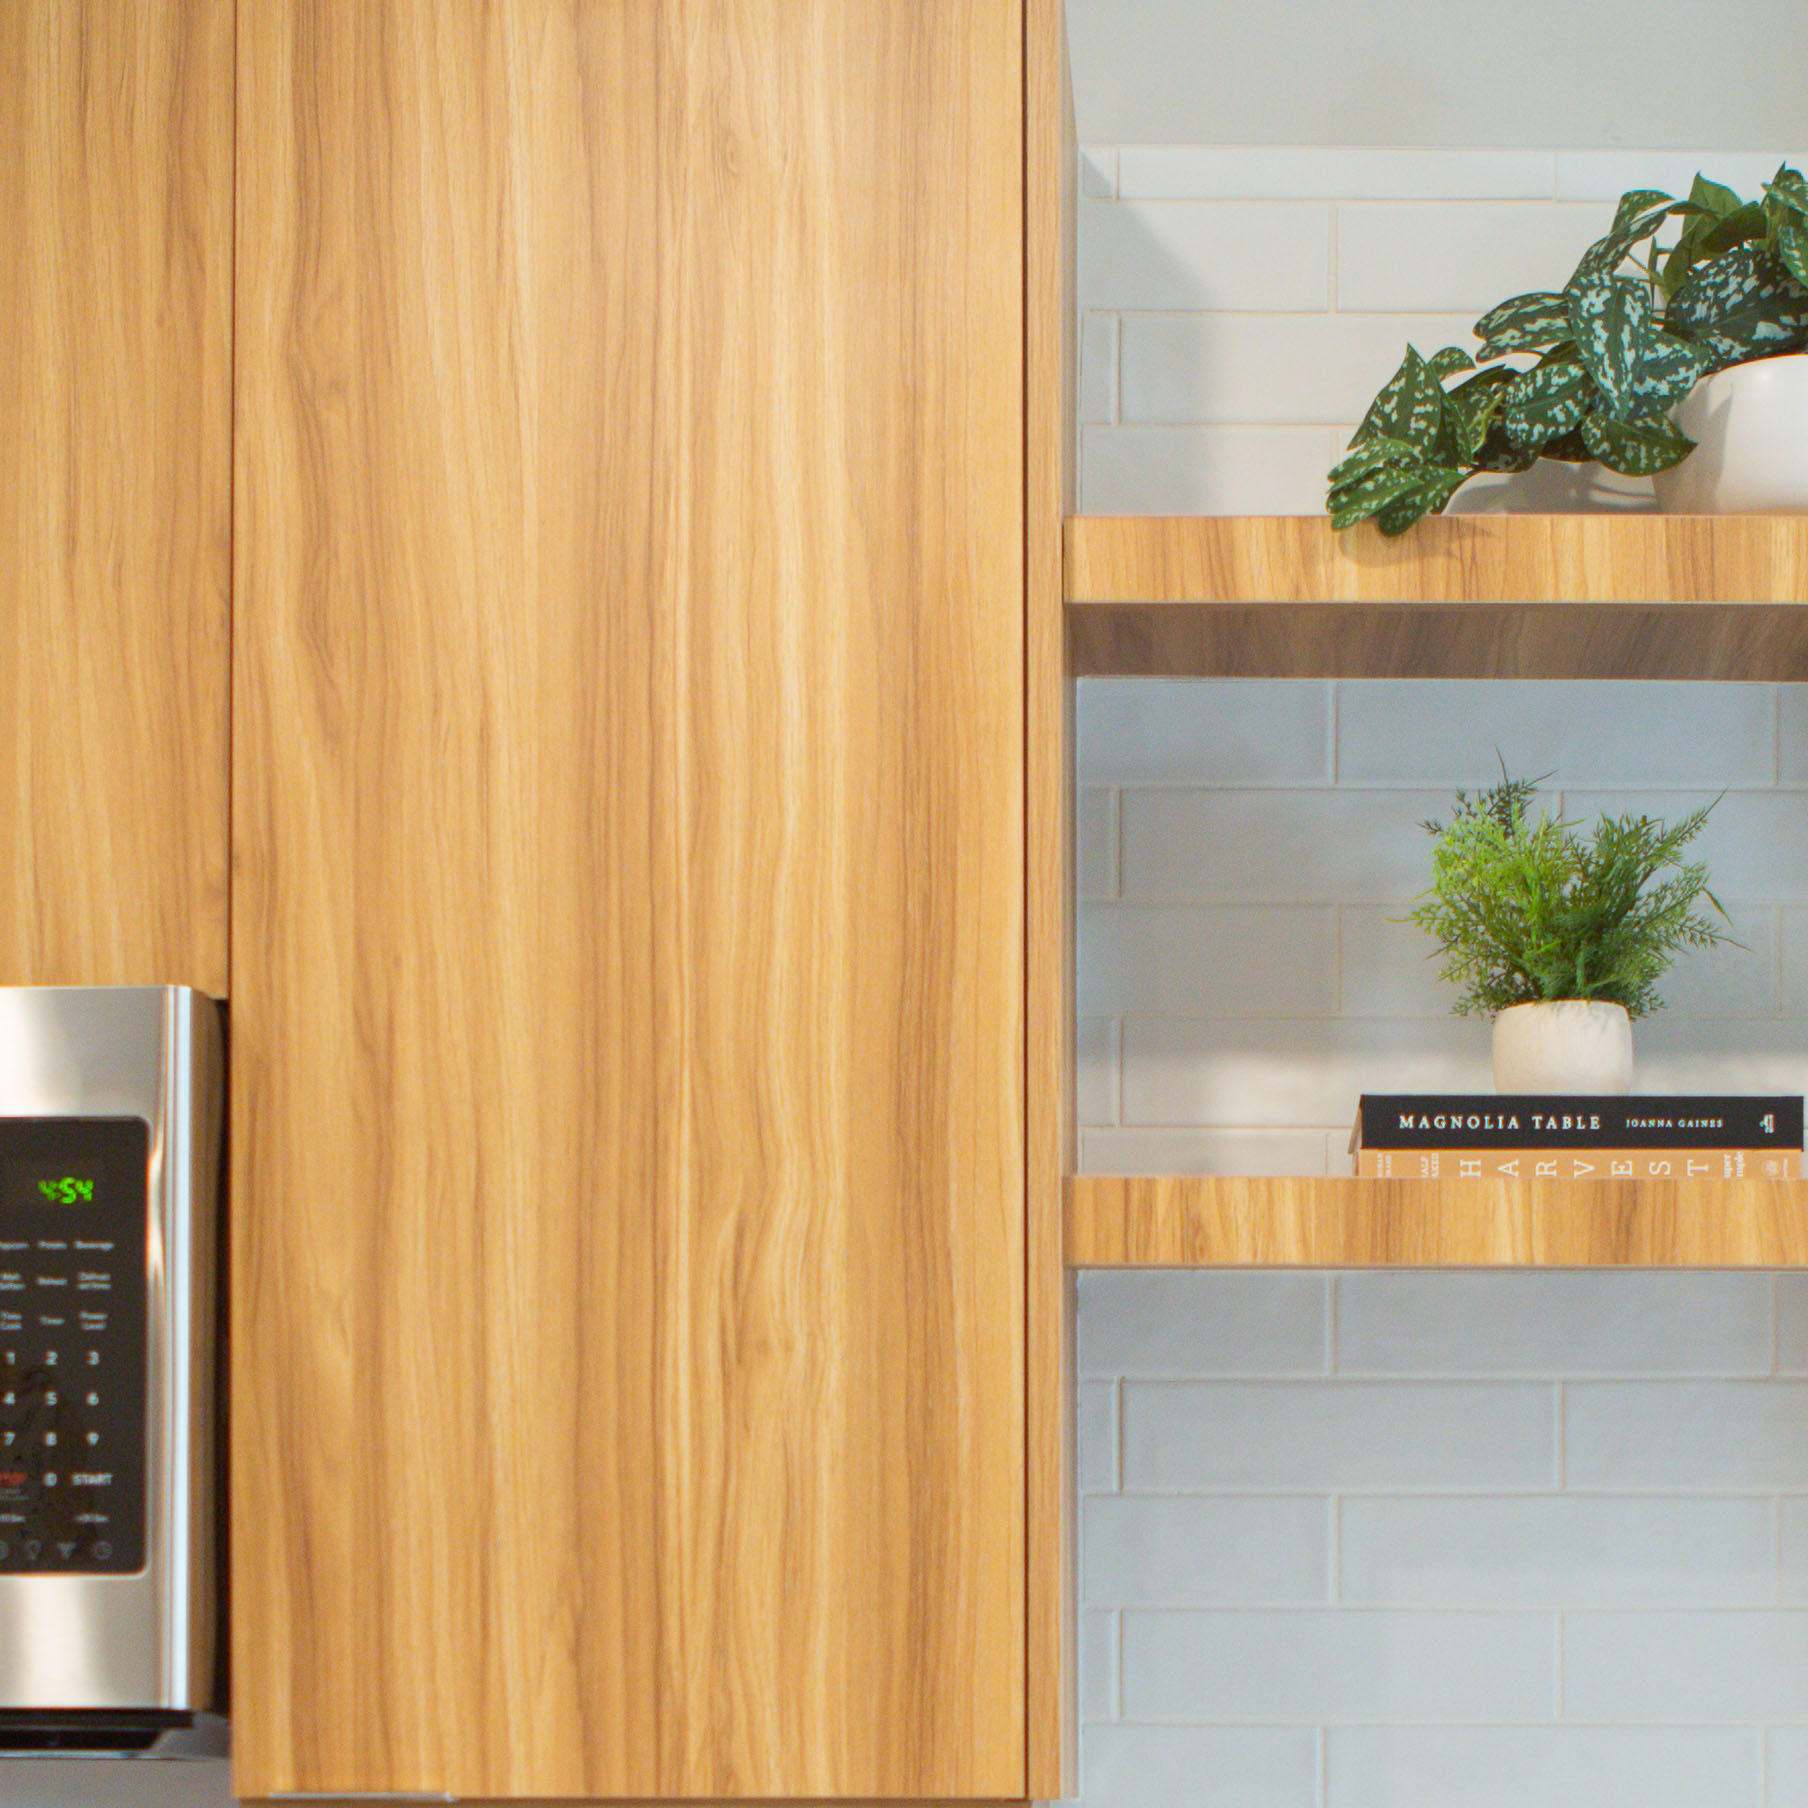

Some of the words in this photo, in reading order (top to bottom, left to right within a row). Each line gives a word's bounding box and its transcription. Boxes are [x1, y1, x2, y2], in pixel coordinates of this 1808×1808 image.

[1399, 1115, 1519, 1130] MAGNOLIA
[1531, 1115, 1600, 1130] TABLE
[1626, 1118, 1673, 1128] JOANNA
[1677, 1119, 1723, 1128] GAINES
[1459, 1159, 1709, 1179] HARVEST
[5, 1351, 16, 1365] 1
[45, 1350, 58, 1366] 2
[87, 1351, 100, 1366] 3
[3, 1391, 16, 1405] 4
[45, 1391, 58, 1406] 5
[86, 1392, 100, 1406] 6
[3, 1431, 16, 1446] 7
[45, 1431, 57, 1447] 8
[86, 1432, 100, 1446] 9
[43, 1471, 58, 1487] 0
[71, 1472, 114, 1487] START
